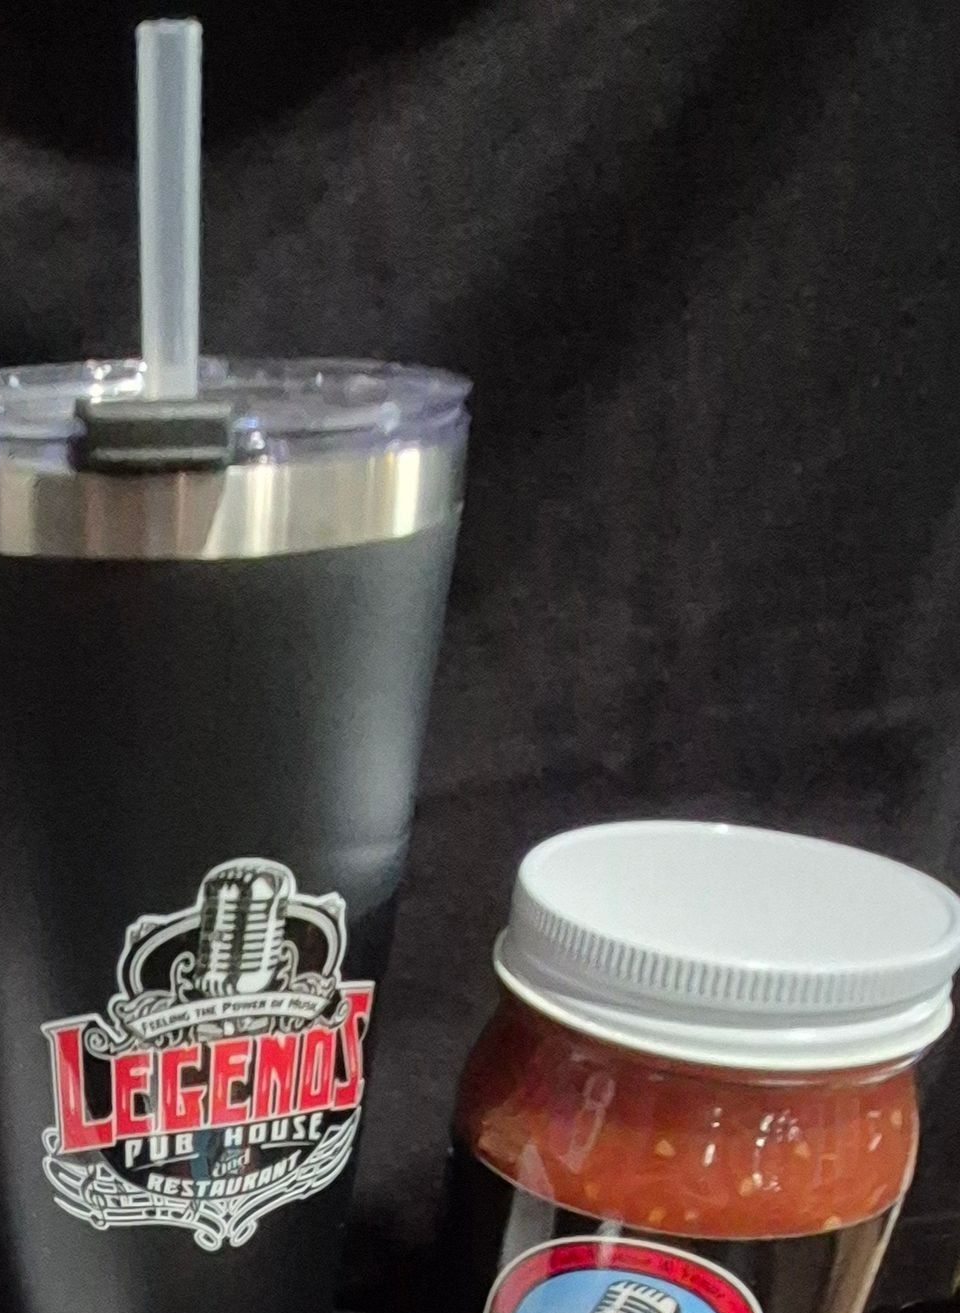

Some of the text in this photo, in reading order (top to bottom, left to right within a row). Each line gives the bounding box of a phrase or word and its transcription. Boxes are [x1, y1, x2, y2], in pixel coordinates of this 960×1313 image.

[43, 982, 374, 1154] LEGENDS
[124, 1112, 324, 1169] PUB HOUSE
[147, 1150, 302, 1197] RESTAURANT
